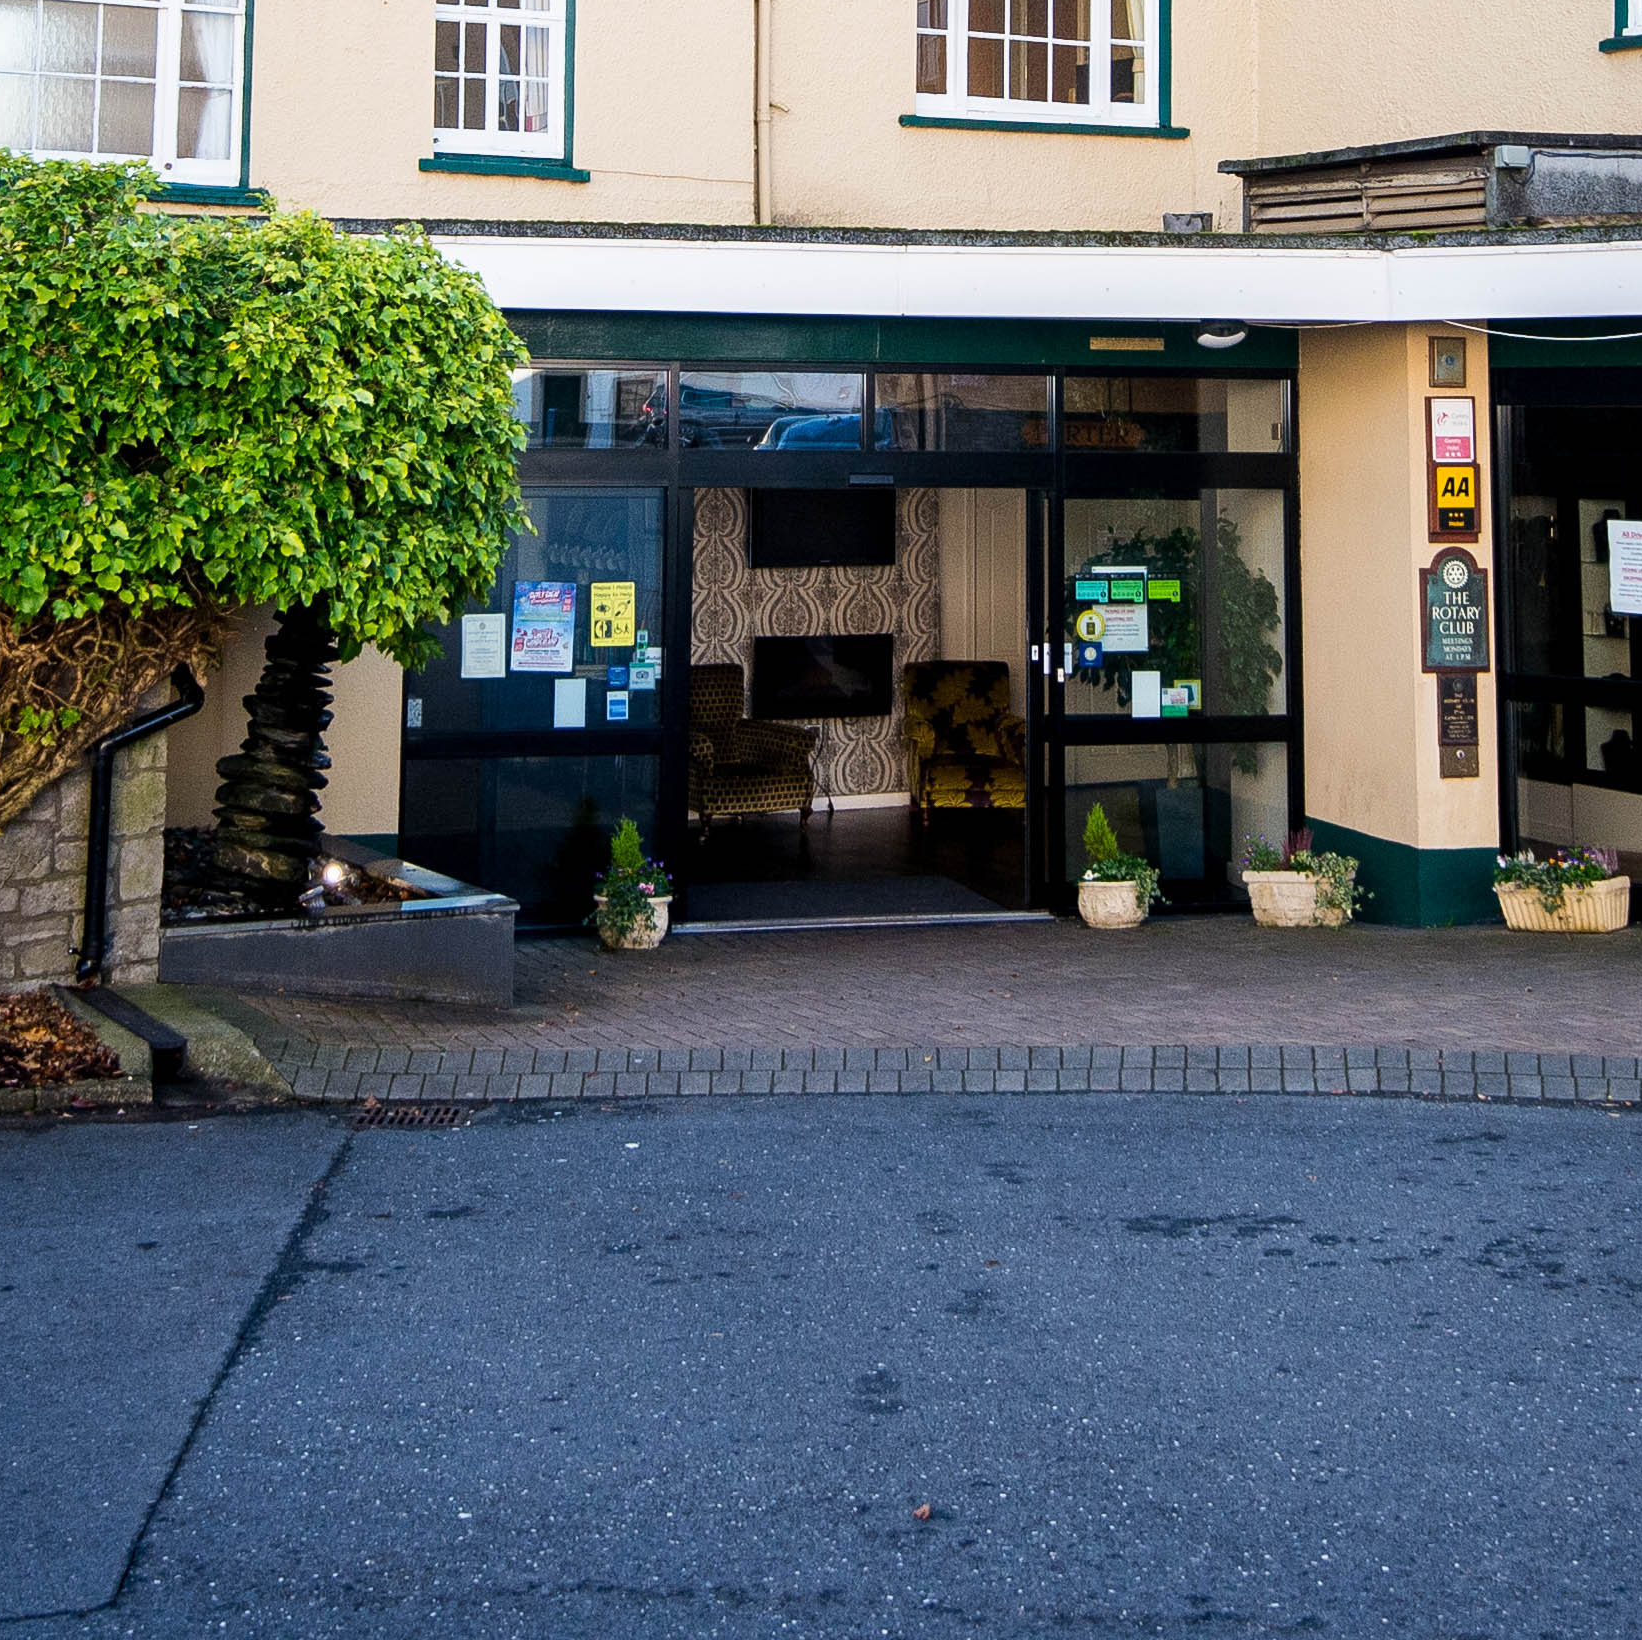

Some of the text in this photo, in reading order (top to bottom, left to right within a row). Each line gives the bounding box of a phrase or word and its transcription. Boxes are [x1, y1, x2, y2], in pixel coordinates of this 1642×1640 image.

[1441, 476, 1470, 498] AA
[1442, 591, 1470, 605] THE
[1431, 606, 1482, 620] ROTARY
[1439, 621, 1475, 635] CLUB
